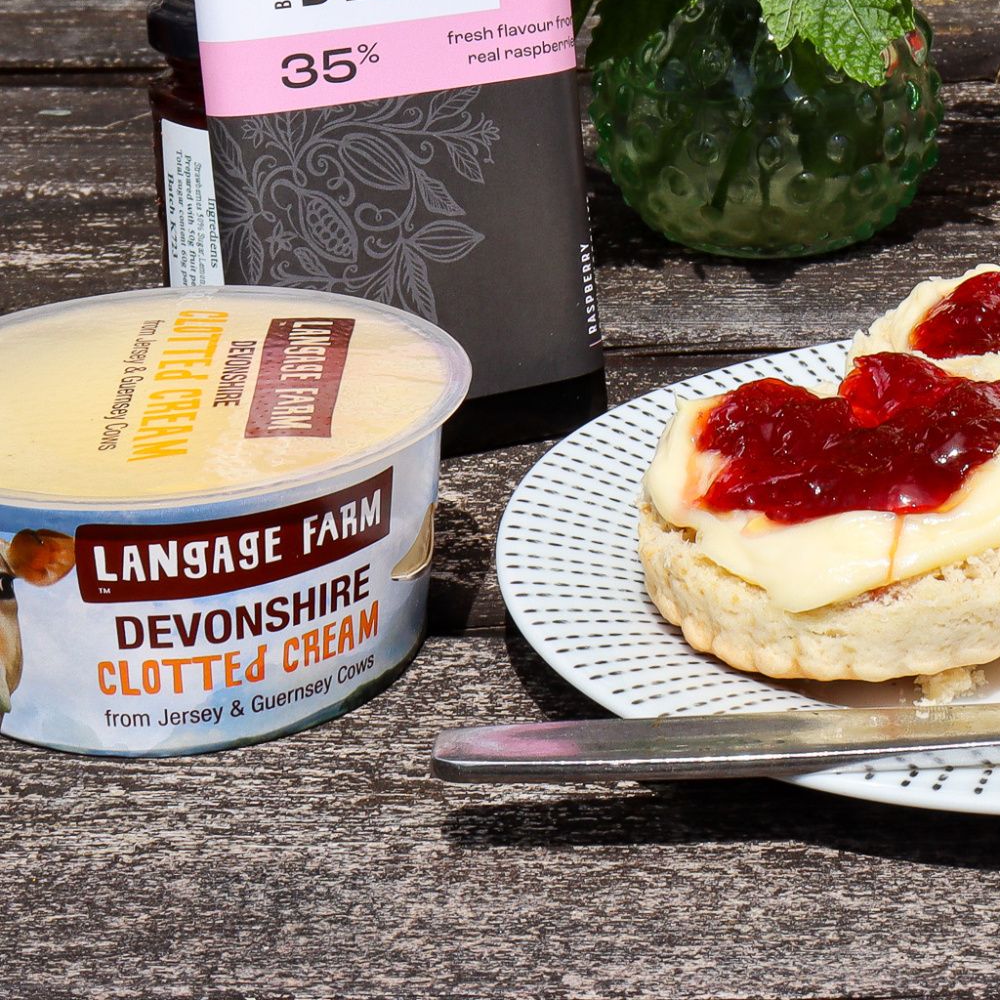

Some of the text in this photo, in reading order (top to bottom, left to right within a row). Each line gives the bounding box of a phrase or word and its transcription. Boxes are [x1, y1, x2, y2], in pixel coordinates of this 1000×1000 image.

[281, 42, 380, 89] 35%
[447, 26, 494, 45] fresh
[497, 20, 554, 38] flavour
[468, 47, 500, 64] real
[168, 173, 176, 214] Batch
[184, 155, 194, 200] Prepared
[176, 150, 188, 286] Total sugar content 60g per
[188, 230, 196, 247] 50g
[206, 198, 218, 269] Ingredients
[188, 275, 197, 286] pe
[190, 250, 198, 272] fruit
[580, 242, 598, 335] RASPBERRY
[98, 320, 166, 452] from Jersey & Guernsey Cows
[213, 340, 258, 408] DEVONSHIRE
[127, 388, 203, 463] CREAM
[268, 387, 318, 432] FARM
[302, 488, 382, 556] FARM
[115, 563, 371, 650] DEVONSHIRE
[282, 600, 380, 674] CREAM
[104, 653, 375, 728] from Jersey & Guernsey Cows
